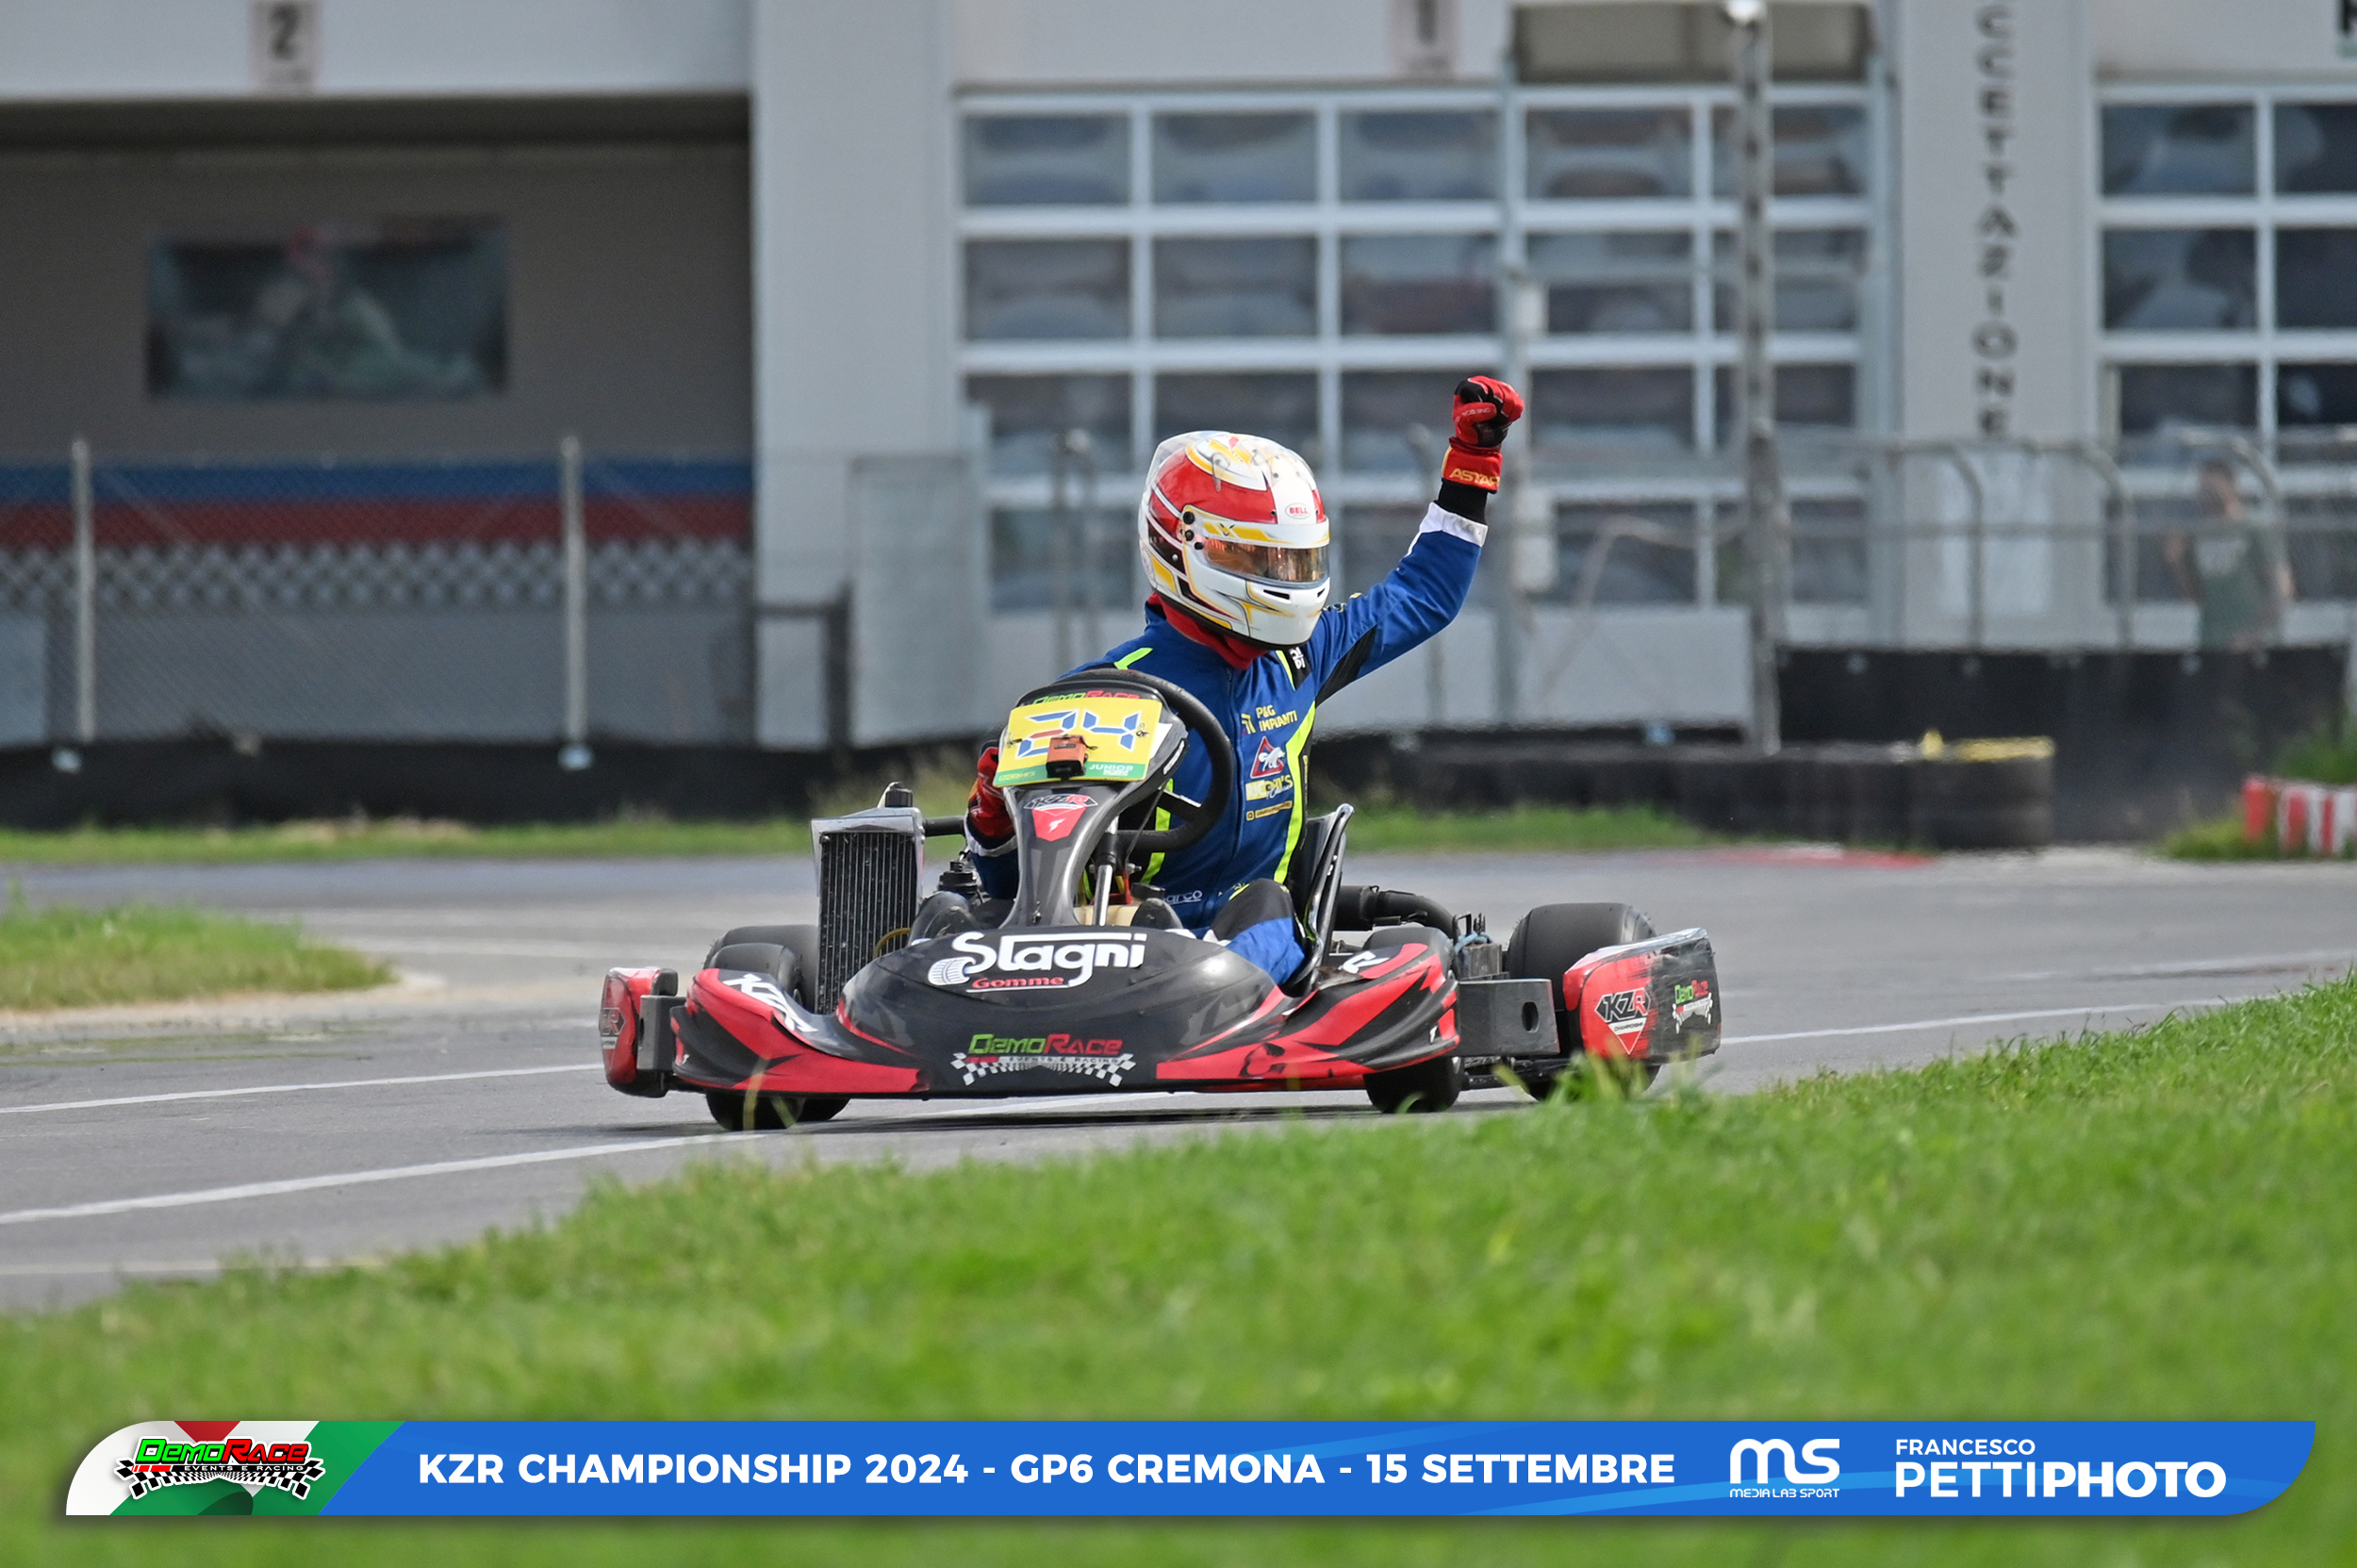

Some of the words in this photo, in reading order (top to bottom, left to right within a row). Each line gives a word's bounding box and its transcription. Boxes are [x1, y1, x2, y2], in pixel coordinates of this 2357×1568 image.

[269, 3, 300, 60] 2
[1289, 506, 1309, 515] BELL
[1256, 704, 1277, 719] P&G
[1259, 710, 1298, 732] IMPIANTI
[1015, 708, 1143, 760] 24
[1163, 890, 1203, 905] arco
[972, 976, 1064, 989] Gomme
[1603, 988, 1649, 1023] KZR
